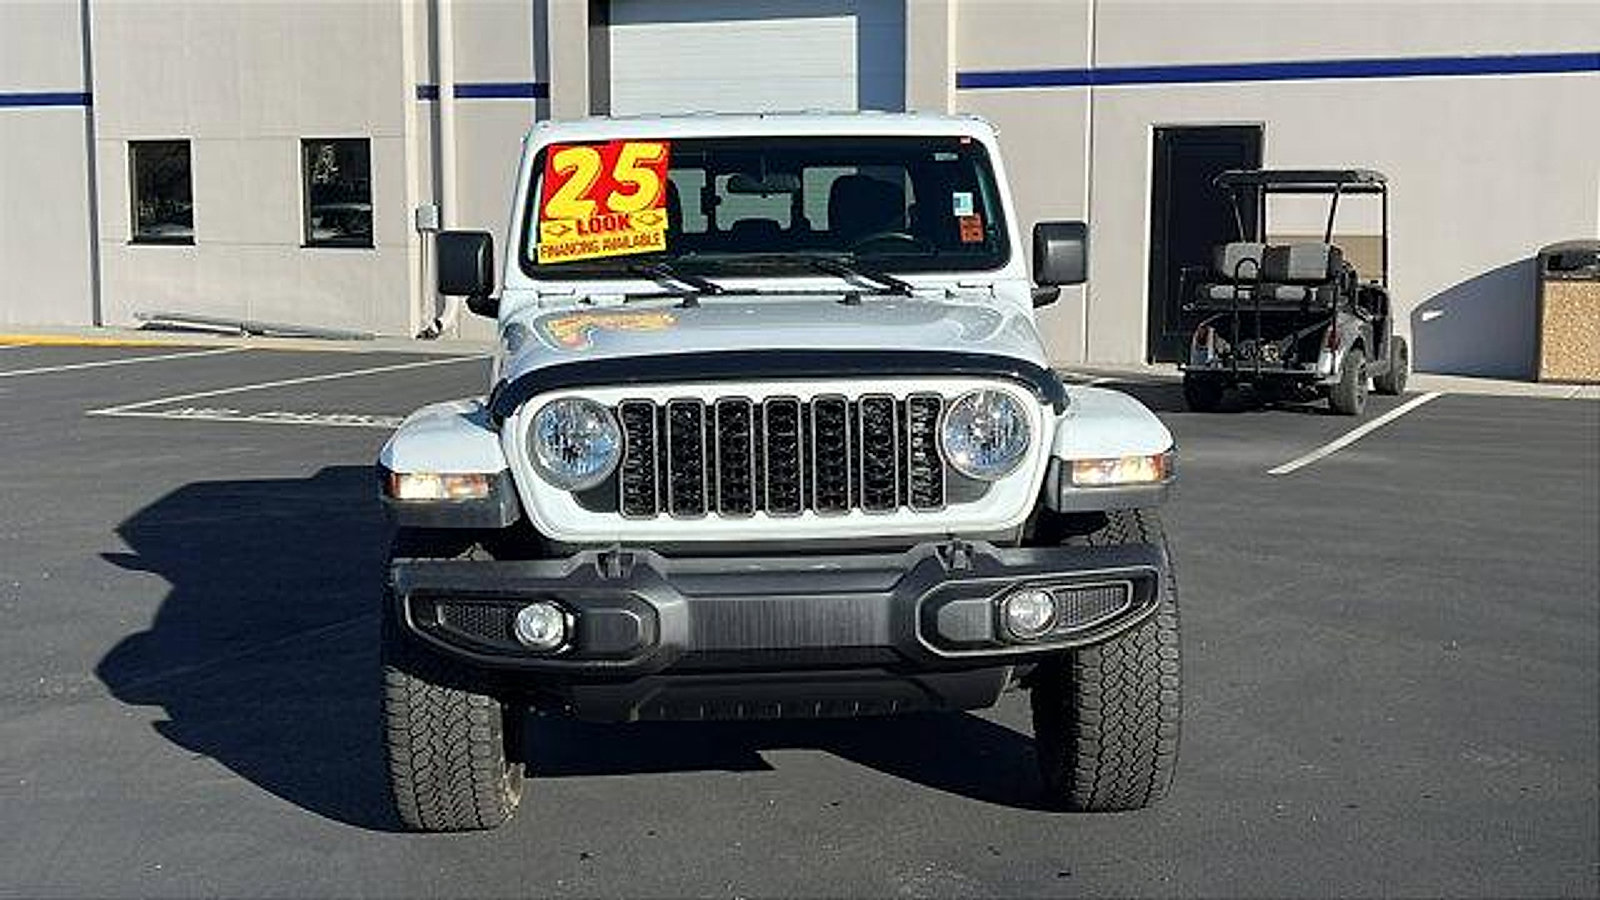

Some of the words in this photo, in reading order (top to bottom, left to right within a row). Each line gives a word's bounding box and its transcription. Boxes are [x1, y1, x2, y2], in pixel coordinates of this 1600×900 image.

[545, 142, 661, 219] 25
[576, 212, 632, 236] LOOK
[540, 240, 601, 258] FINANCING
[602, 232, 662, 251] AVAILABLE
